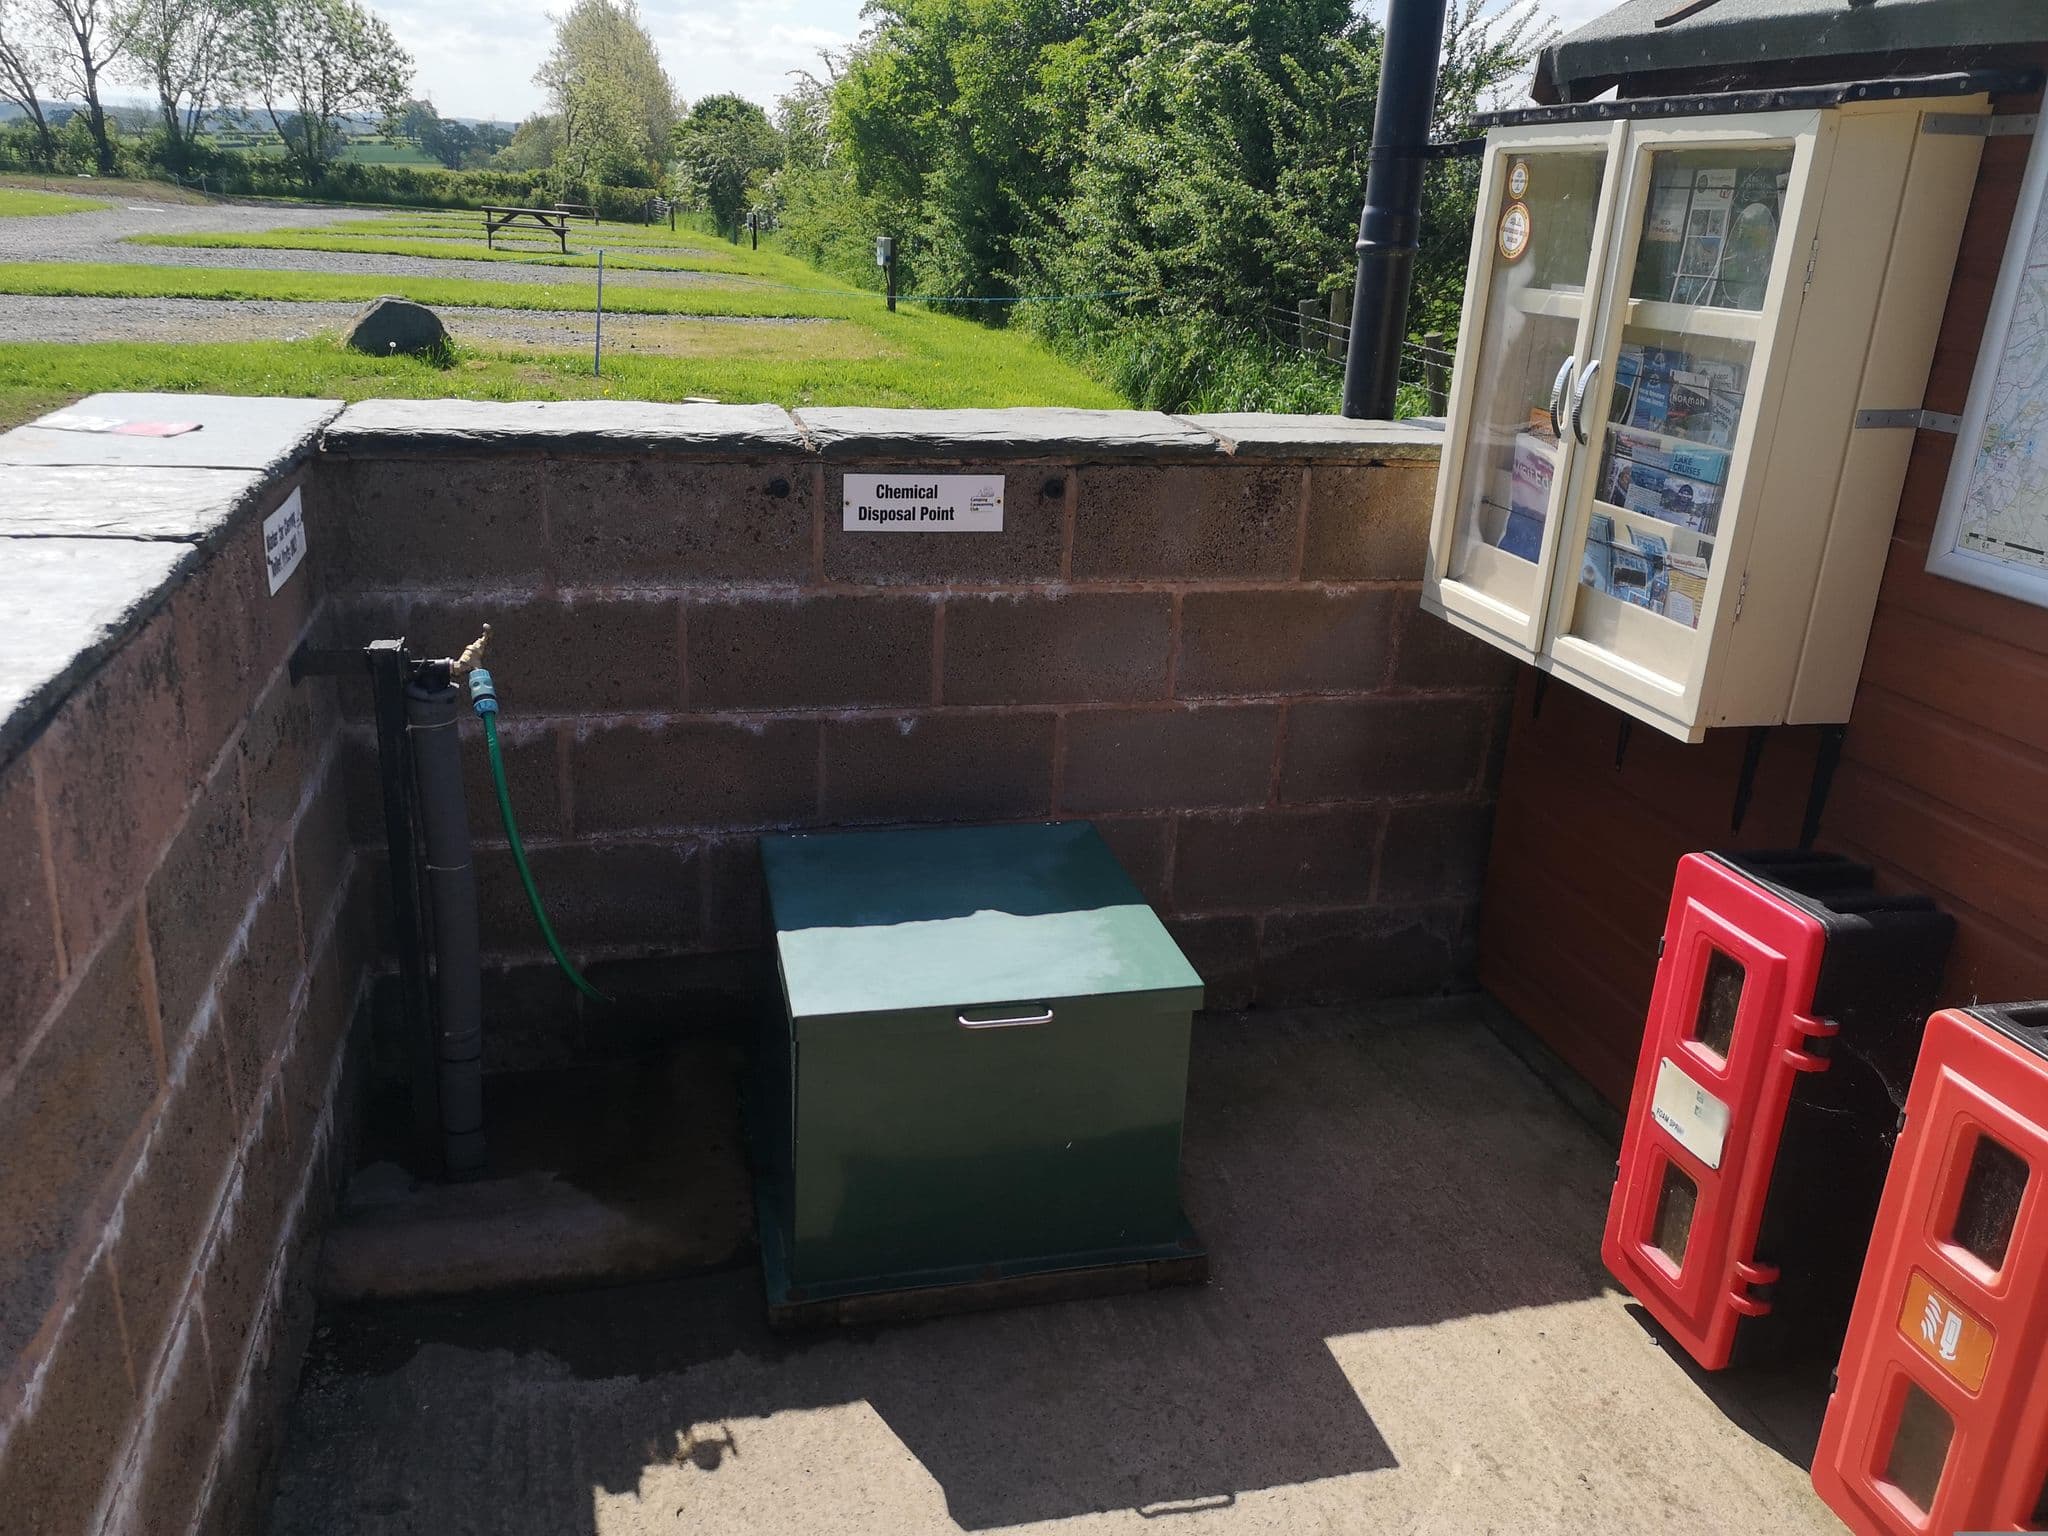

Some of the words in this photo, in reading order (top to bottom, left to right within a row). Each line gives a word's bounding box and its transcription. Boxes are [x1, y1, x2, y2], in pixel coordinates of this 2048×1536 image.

[1674, 455, 1693, 466] LAKE
[1673, 463, 1701, 476] CRUISES
[876, 484, 938, 499] Chemical
[858, 506, 916, 524] Disposal
[920, 506, 955, 521] Point
[1656, 1107, 1670, 1122] FOAM
